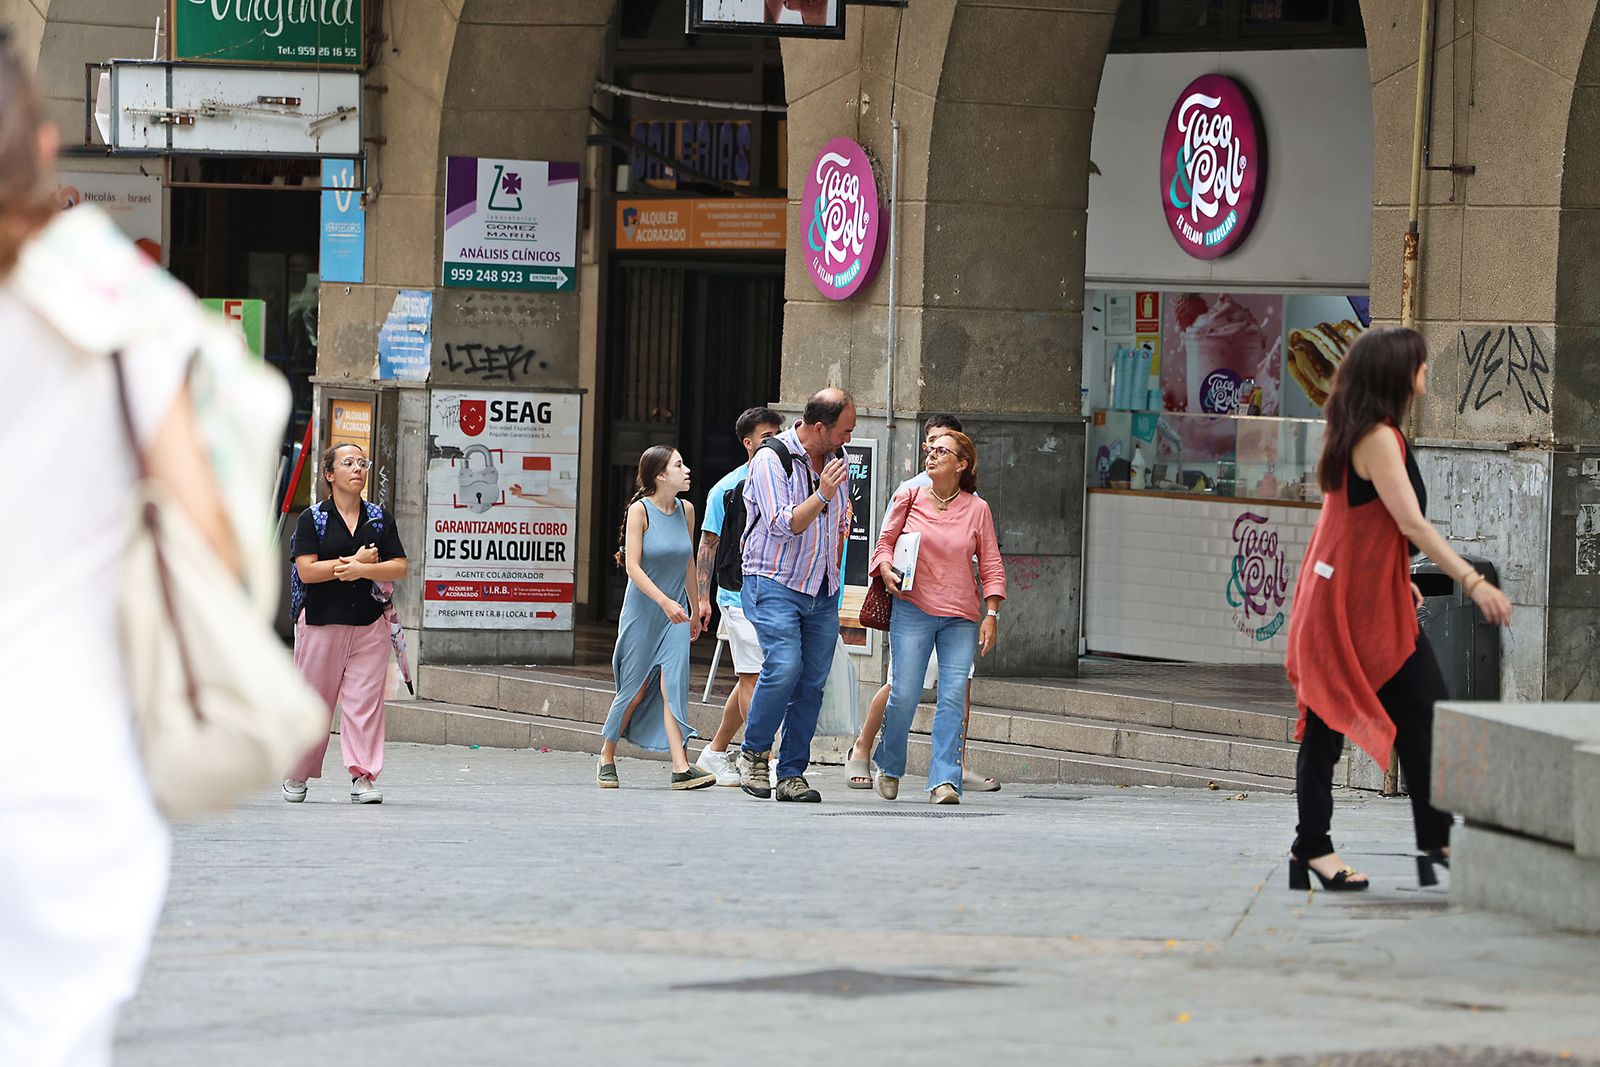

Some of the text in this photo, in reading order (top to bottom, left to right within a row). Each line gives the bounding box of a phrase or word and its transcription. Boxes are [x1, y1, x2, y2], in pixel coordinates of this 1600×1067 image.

[298, 47, 315, 56] 959
[318, 48, 329, 56] 26
[332, 48, 342, 56] 16
[345, 48, 357, 57] 55
[1178, 93, 1232, 163] Taco
[816, 152, 860, 212] Taco
[84, 192, 152, 204] Nicolás Israel
[640, 211, 679, 225] ALQUILER
[636, 229, 687, 242] ACORAZADO
[459, 246, 561, 262] ANÁLISIS CLÍNICOS
[451, 269, 523, 283] 959 248 923
[1208, 374, 1234, 397] Taco
[490, 400, 552, 424] SEAG
[848, 465, 868, 480] FFLE
[435, 520, 568, 536] GARANTIZAMOS EL COBRO
[1232, 512, 1278, 568] Taco
[434, 539, 566, 562] DE SU ALQUILER
[455, 571, 544, 580] AGENTE COLABORADOR
